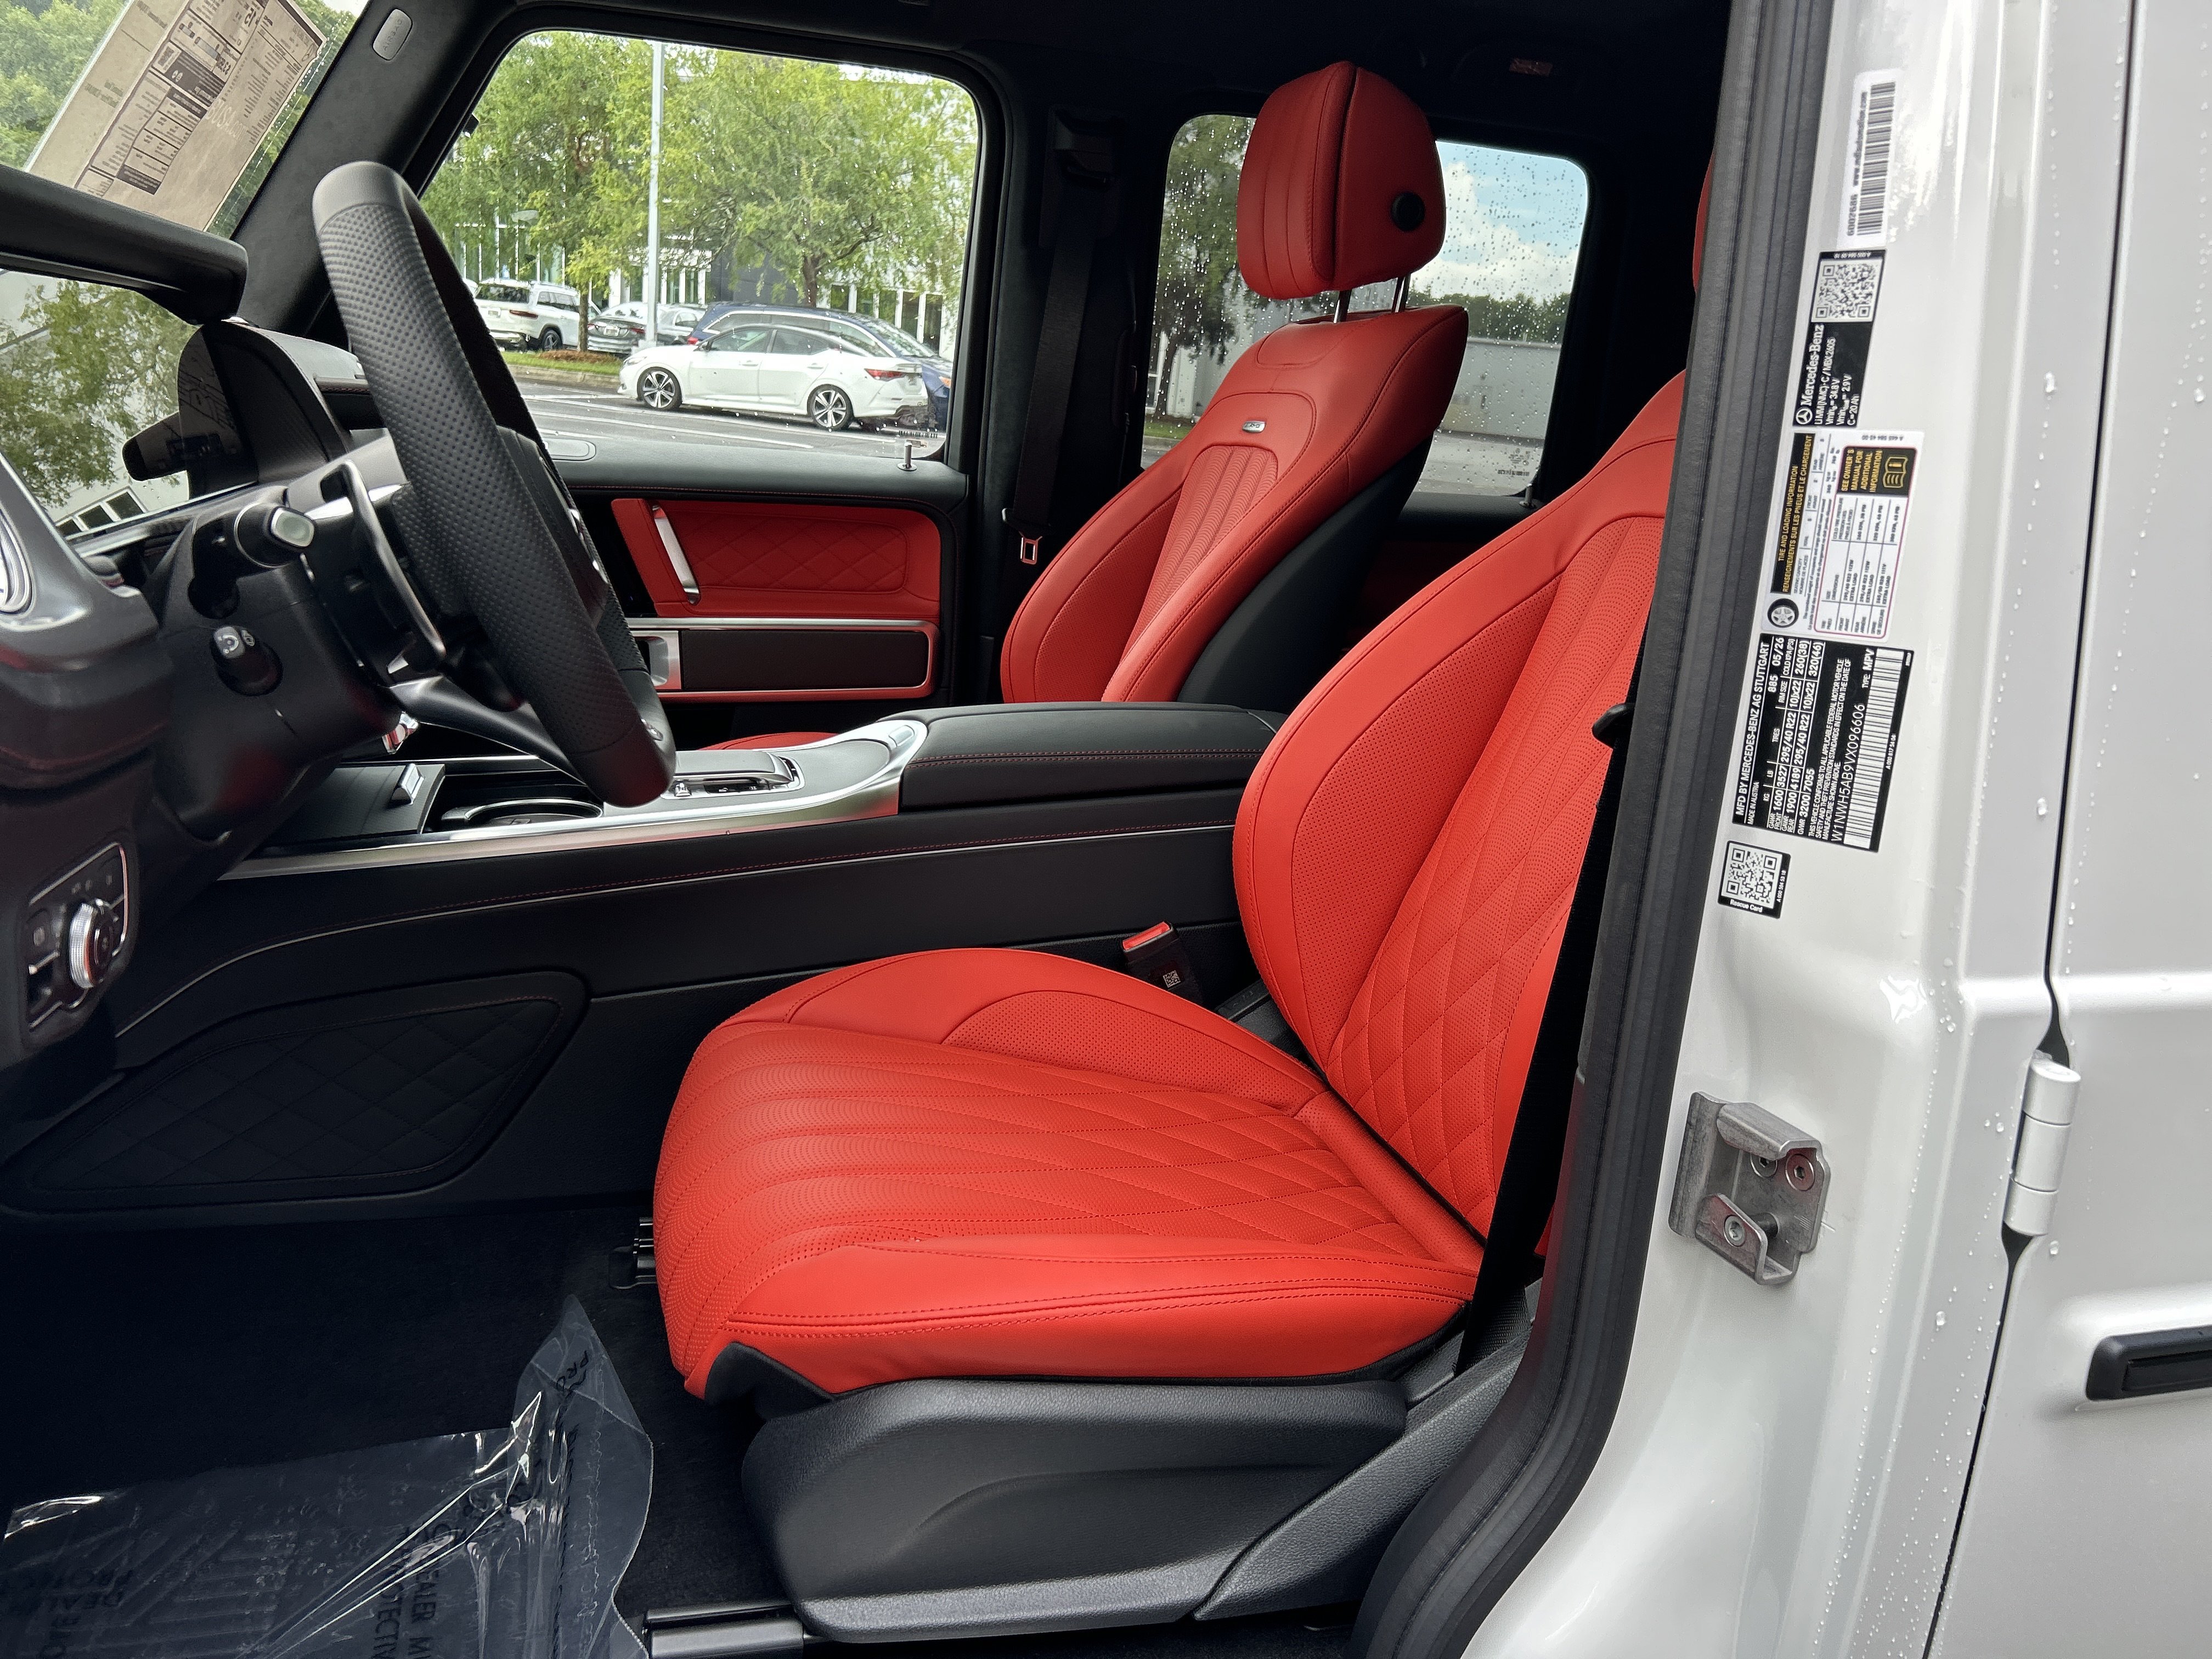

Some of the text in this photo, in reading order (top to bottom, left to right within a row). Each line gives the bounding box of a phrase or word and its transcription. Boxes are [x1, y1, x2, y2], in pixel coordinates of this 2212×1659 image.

[1800, 324, 1825, 406] Mercedes-Benz
[1800, 435, 1812, 476] CHARGEMENT
[1850, 450, 1863, 490] MANUAL FOR
[1860, 453, 1872, 489] ADDITIONAL
[1869, 450, 1882, 492] INFORMATION
[1786, 466, 1798, 506] INFORMATION
[1797, 484, 1804, 493] ET
[1794, 493, 1803, 514] PNEUS
[1782, 507, 1792, 533] LOADING
[1780, 534, 1788, 547] AND
[1790, 526, 1798, 539] SUR
[1782, 540, 1796, 592] RENSEIGNEMENTS
[1771, 637, 1785, 667] 05/26
[1843, 658, 1851, 667] OF
[1782, 661, 1791, 675] COLD
[1841, 667, 1849, 681] DATE
[1767, 674, 1778, 693] 885
[1830, 681, 1840, 701] MOTOR
[1839, 681, 1847, 692] THE
[1837, 692, 1846, 701] ON
[1786, 712, 1796, 729] R22
[1826, 701, 1837, 724] FEDERAL
[1835, 701, 1844, 720] EFFECT
[1735, 642, 1769, 815] MFD BY MERCEDES-BENZ AG STUTTGART
[1799, 713, 1810, 731] R22
[1771, 727, 1780, 743] TIRES
[1821, 724, 1833, 755] APPLICABLE
[1828, 727, 1839, 759] STANDARDS
[1830, 703, 1865, 843] W1NWH5AB9VX096606
[1862, 648, 1875, 670] MPV
[1780, 730, 1795, 763] 295/40
[1793, 732, 1808, 765] 295/40
[1820, 755, 1828, 765] ALL
[1766, 769, 1773, 777] LB
[1776, 764, 1788, 787] 3527
[1790, 767, 1801, 790] 4189
[1803, 767, 1815, 792] 7055
[1822, 759, 1834, 791] PREVENTION
[1750, 781, 1759, 803] AUSTRIA
[1763, 793, 1770, 802] KG
[1813, 773, 1825, 803] CONFORMS
[1820, 791, 1829, 807] THEFT
[1773, 788, 1784, 811] 1600
[1786, 791, 1797, 814] 1900
[1799, 793, 1810, 817] 3200
[1821, 800, 1835, 839] MANUFACTURE
[1828, 780, 1838, 801] SHOWN
[1747, 809, 1755, 825] MADE
[1810, 803, 1820, 825] VEHICLE
[1818, 807, 1826, 819] AND
[1808, 825, 1816, 837] THIS
[1815, 819, 1824, 838] SAFETY
[1750, 904, 1763, 913] Card
